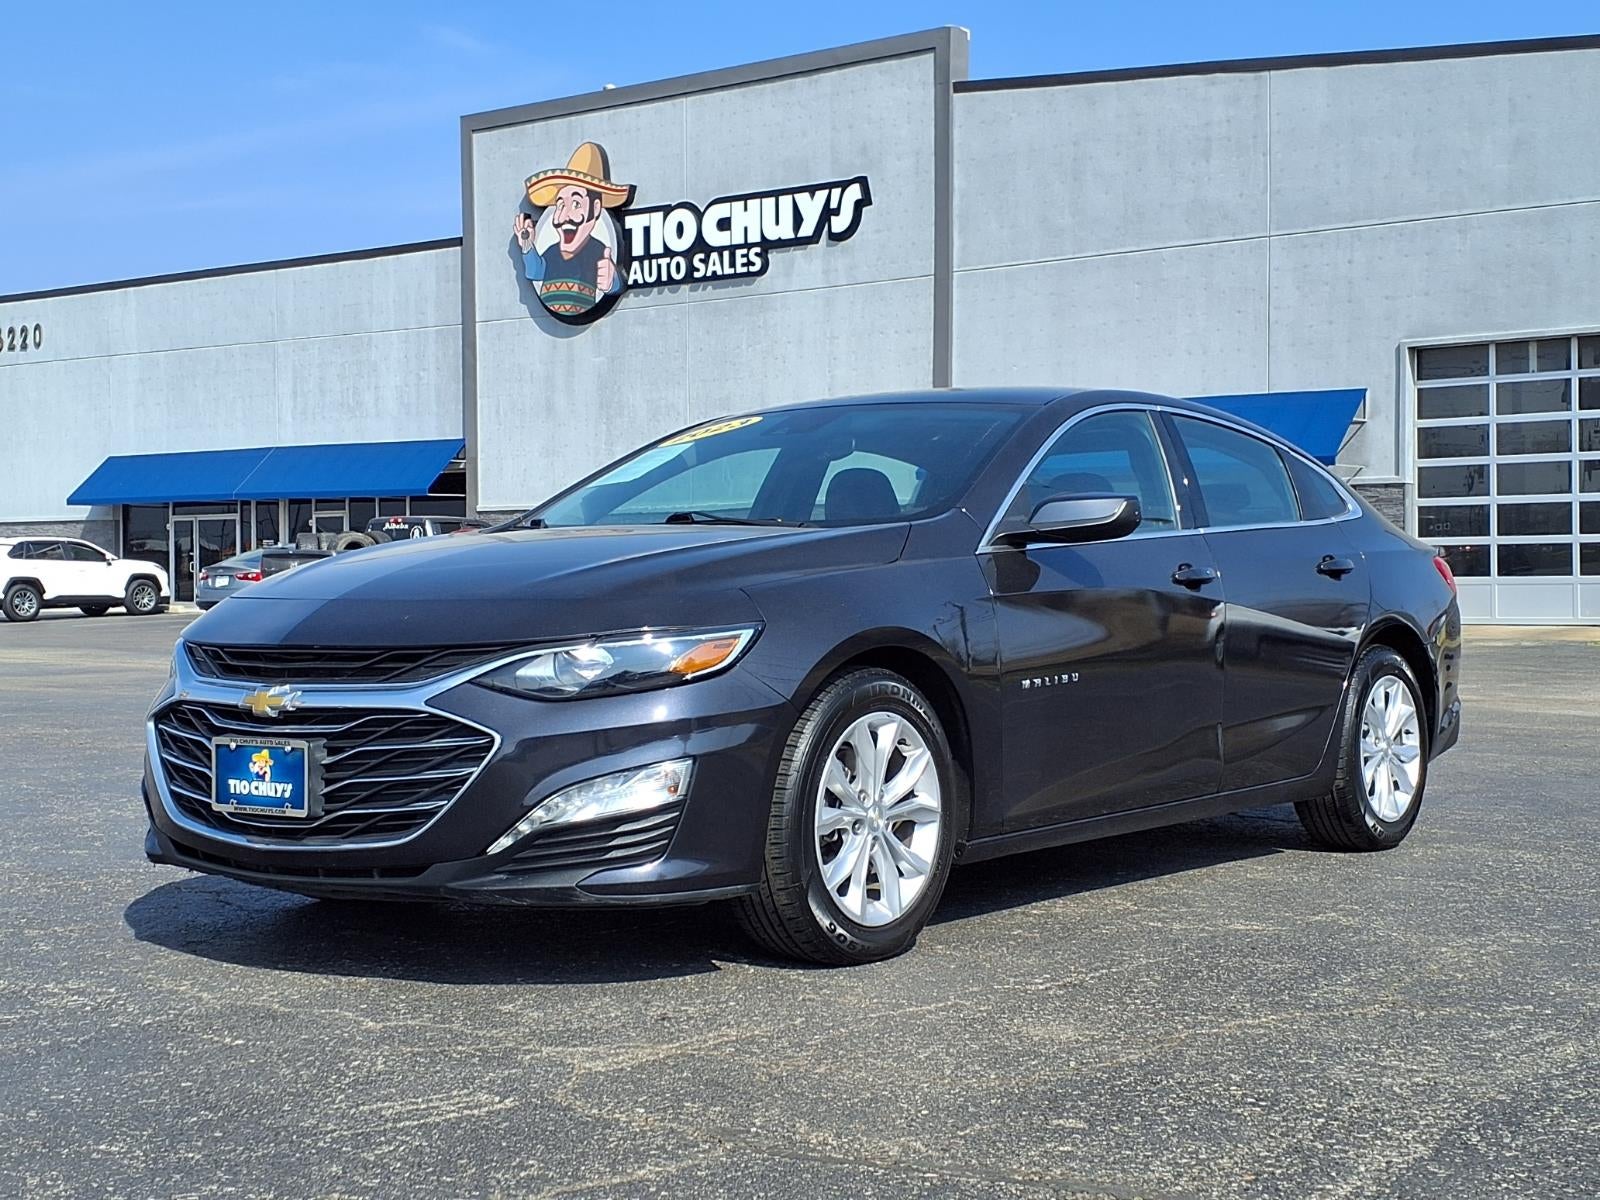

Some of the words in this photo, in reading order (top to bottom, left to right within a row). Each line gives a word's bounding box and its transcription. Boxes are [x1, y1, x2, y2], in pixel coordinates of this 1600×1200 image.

[625, 207, 698, 257] TIO
[701, 182, 863, 247] CHUY'S
[628, 256, 686, 286] AUTO
[693, 247, 763, 278] SALES
[1021, 672, 1079, 689] MALIBU
[228, 779, 250, 795] TIO
[250, 781, 293, 799] CHUY'S
